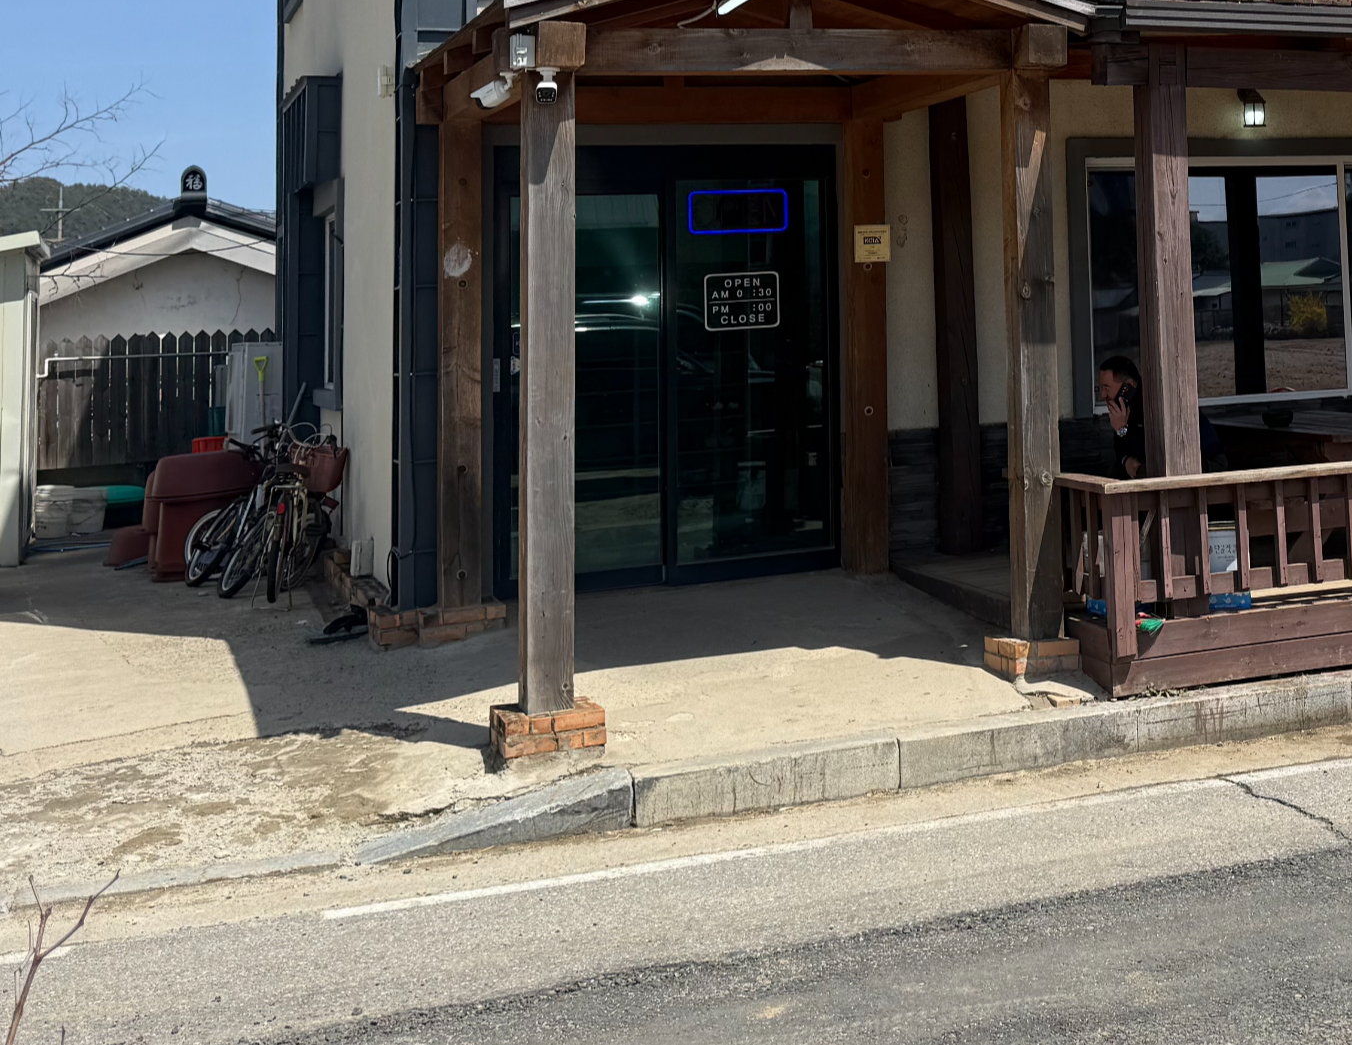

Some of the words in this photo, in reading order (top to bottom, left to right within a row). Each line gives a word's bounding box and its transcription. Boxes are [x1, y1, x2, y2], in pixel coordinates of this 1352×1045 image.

[724, 278, 760, 288] OPEN
[711, 290, 729, 299] AM
[712, 305, 729, 314] PM
[720, 314, 765, 324] CLOSE
